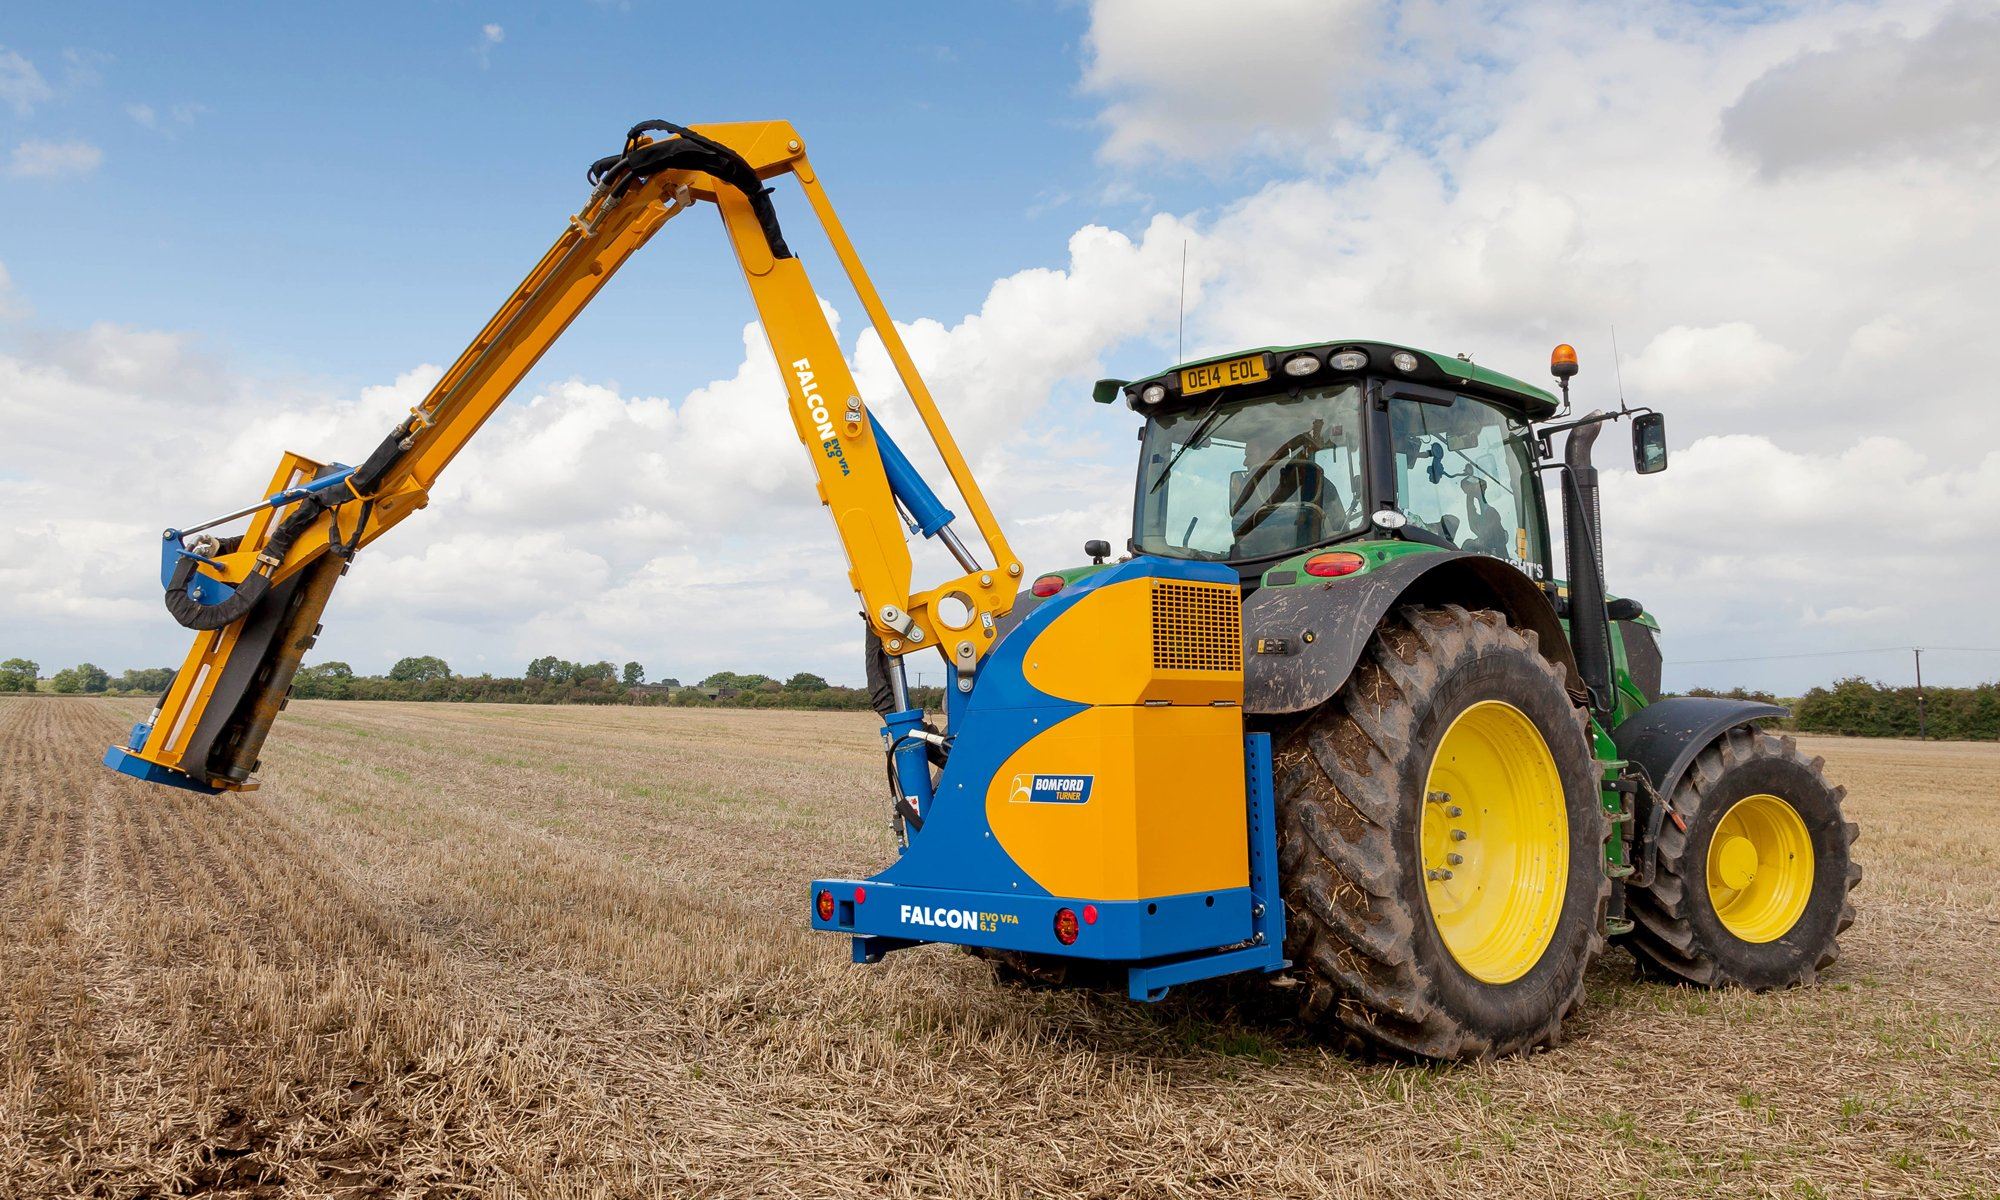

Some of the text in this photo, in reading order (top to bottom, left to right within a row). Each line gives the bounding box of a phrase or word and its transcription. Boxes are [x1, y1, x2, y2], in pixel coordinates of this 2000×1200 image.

[1188, 360, 1260, 388] OE14 EOL
[792, 357, 836, 441] FALCON
[823, 441, 835, 458] 6.5
[831, 438, 850, 477] EVO VFA
[1035, 778, 1084, 791] BOMFORD
[1056, 791, 1081, 800] TURNER
[901, 904, 978, 931] FALCON
[979, 911, 1019, 925] EVO VFA
[980, 921, 997, 933] 6.5
